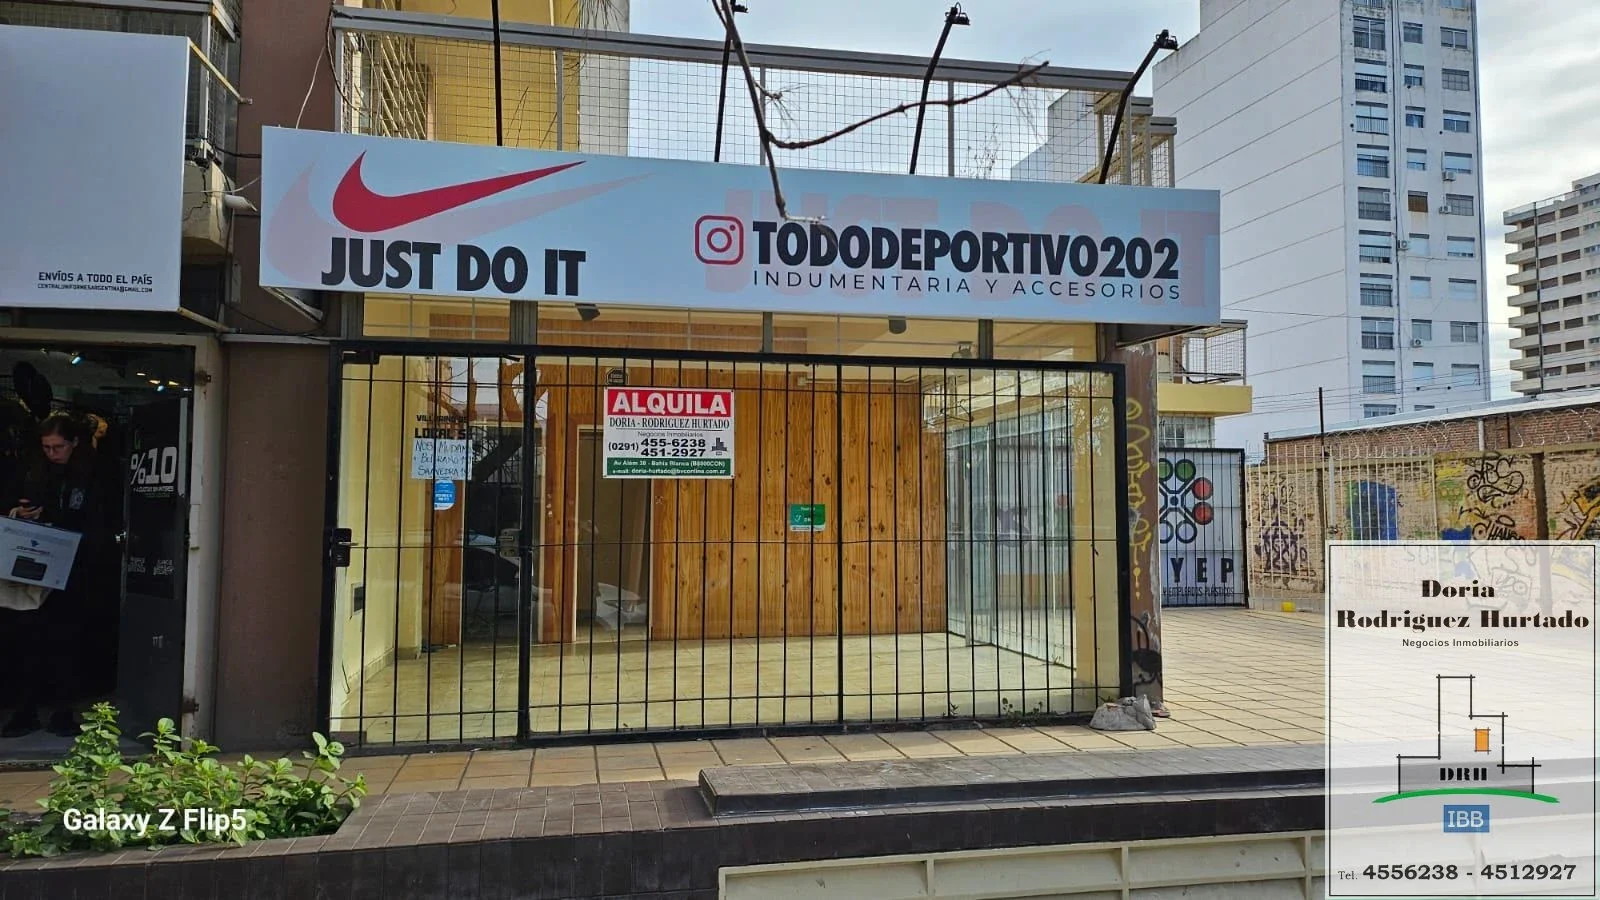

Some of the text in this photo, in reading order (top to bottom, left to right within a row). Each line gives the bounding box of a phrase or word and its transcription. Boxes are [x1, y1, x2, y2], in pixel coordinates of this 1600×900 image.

[752, 220, 1179, 280] TODODEPORTIVO202
[321, 236, 586, 297] JUST DO IT
[38, 270, 153, 285] ENVÍOS A TODO EL PAÍS
[754, 269, 1180, 300] INDUMENTARIA Y ACCESORIOS
[612, 391, 727, 415] ALQUILA
[609, 417, 636, 428] DORIA
[642, 418, 690, 429] RODRIGUEZ
[692, 419, 730, 429] HURTADO
[608, 442, 639, 452] (0291)
[641, 438, 706, 448] 455-6238
[641, 448, 706, 457] 451-2927
[130, 446, 177, 485] %10
